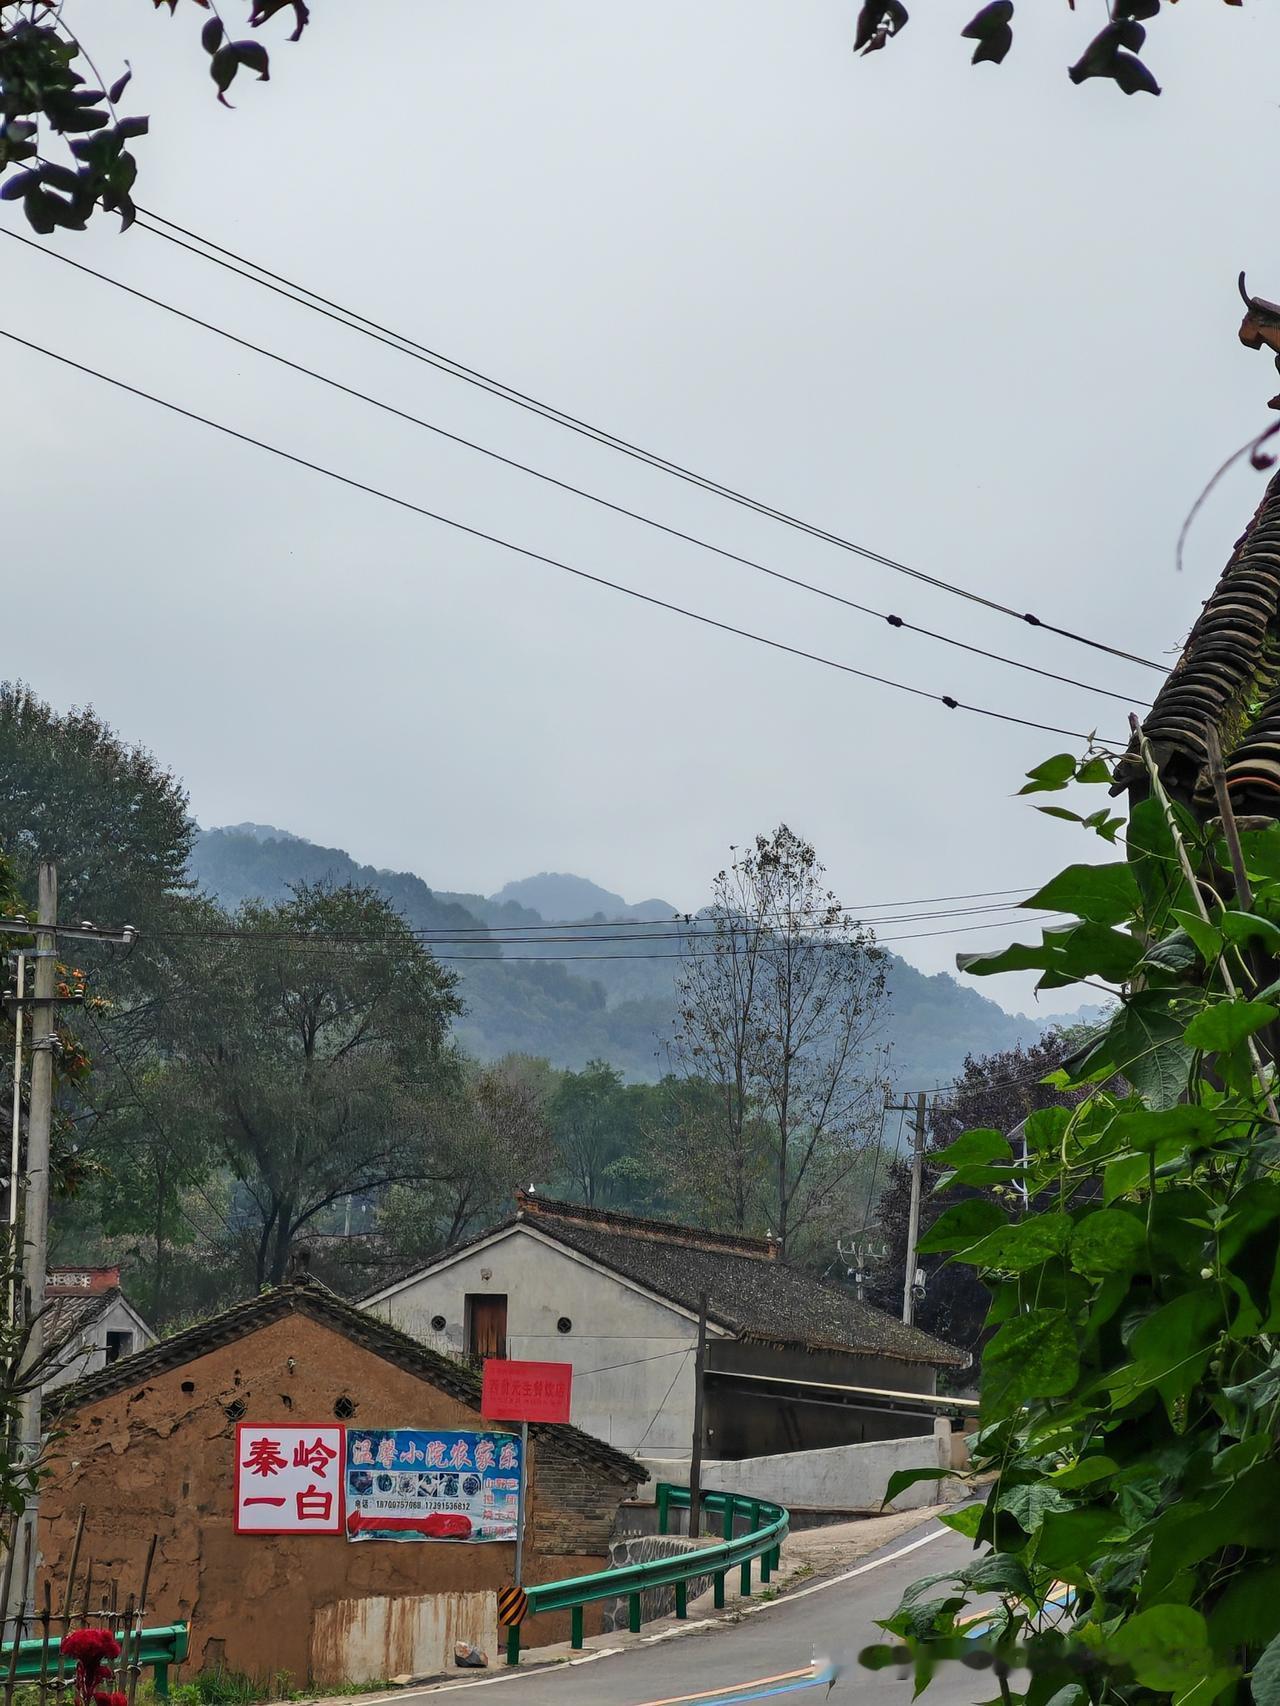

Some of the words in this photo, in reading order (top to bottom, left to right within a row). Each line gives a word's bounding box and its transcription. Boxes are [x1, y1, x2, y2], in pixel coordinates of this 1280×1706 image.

[242, 1437, 337, 1478] 秦岭
[352, 1438, 519, 1471] 温馨小院农家乐
[243, 1484, 333, 1520] 一白
